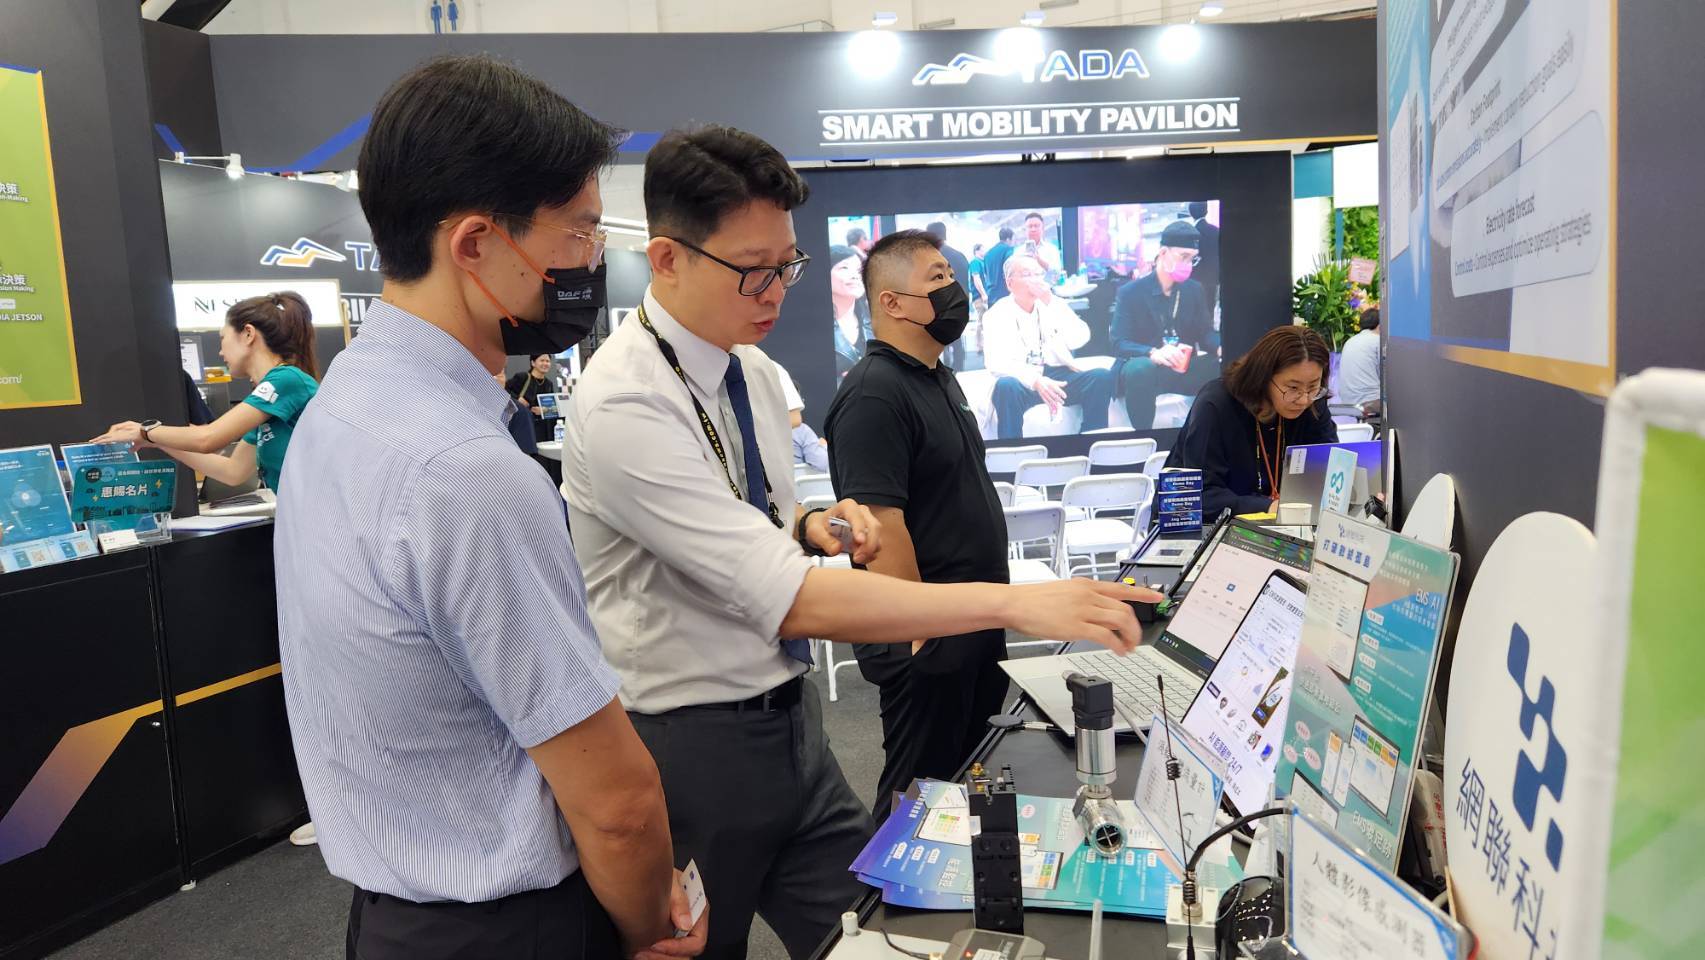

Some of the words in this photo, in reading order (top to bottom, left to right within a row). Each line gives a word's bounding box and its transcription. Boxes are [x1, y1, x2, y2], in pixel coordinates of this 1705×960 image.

[822, 113, 933, 141] SMART
[942, 108, 1092, 138] MOBILITY
[1099, 102, 1239, 131] PAVILION
[12, 313, 43, 321] JETSON
[101, 484, 148, 498] 惠賜名片
[1456, 757, 1561, 960] 網聯科
